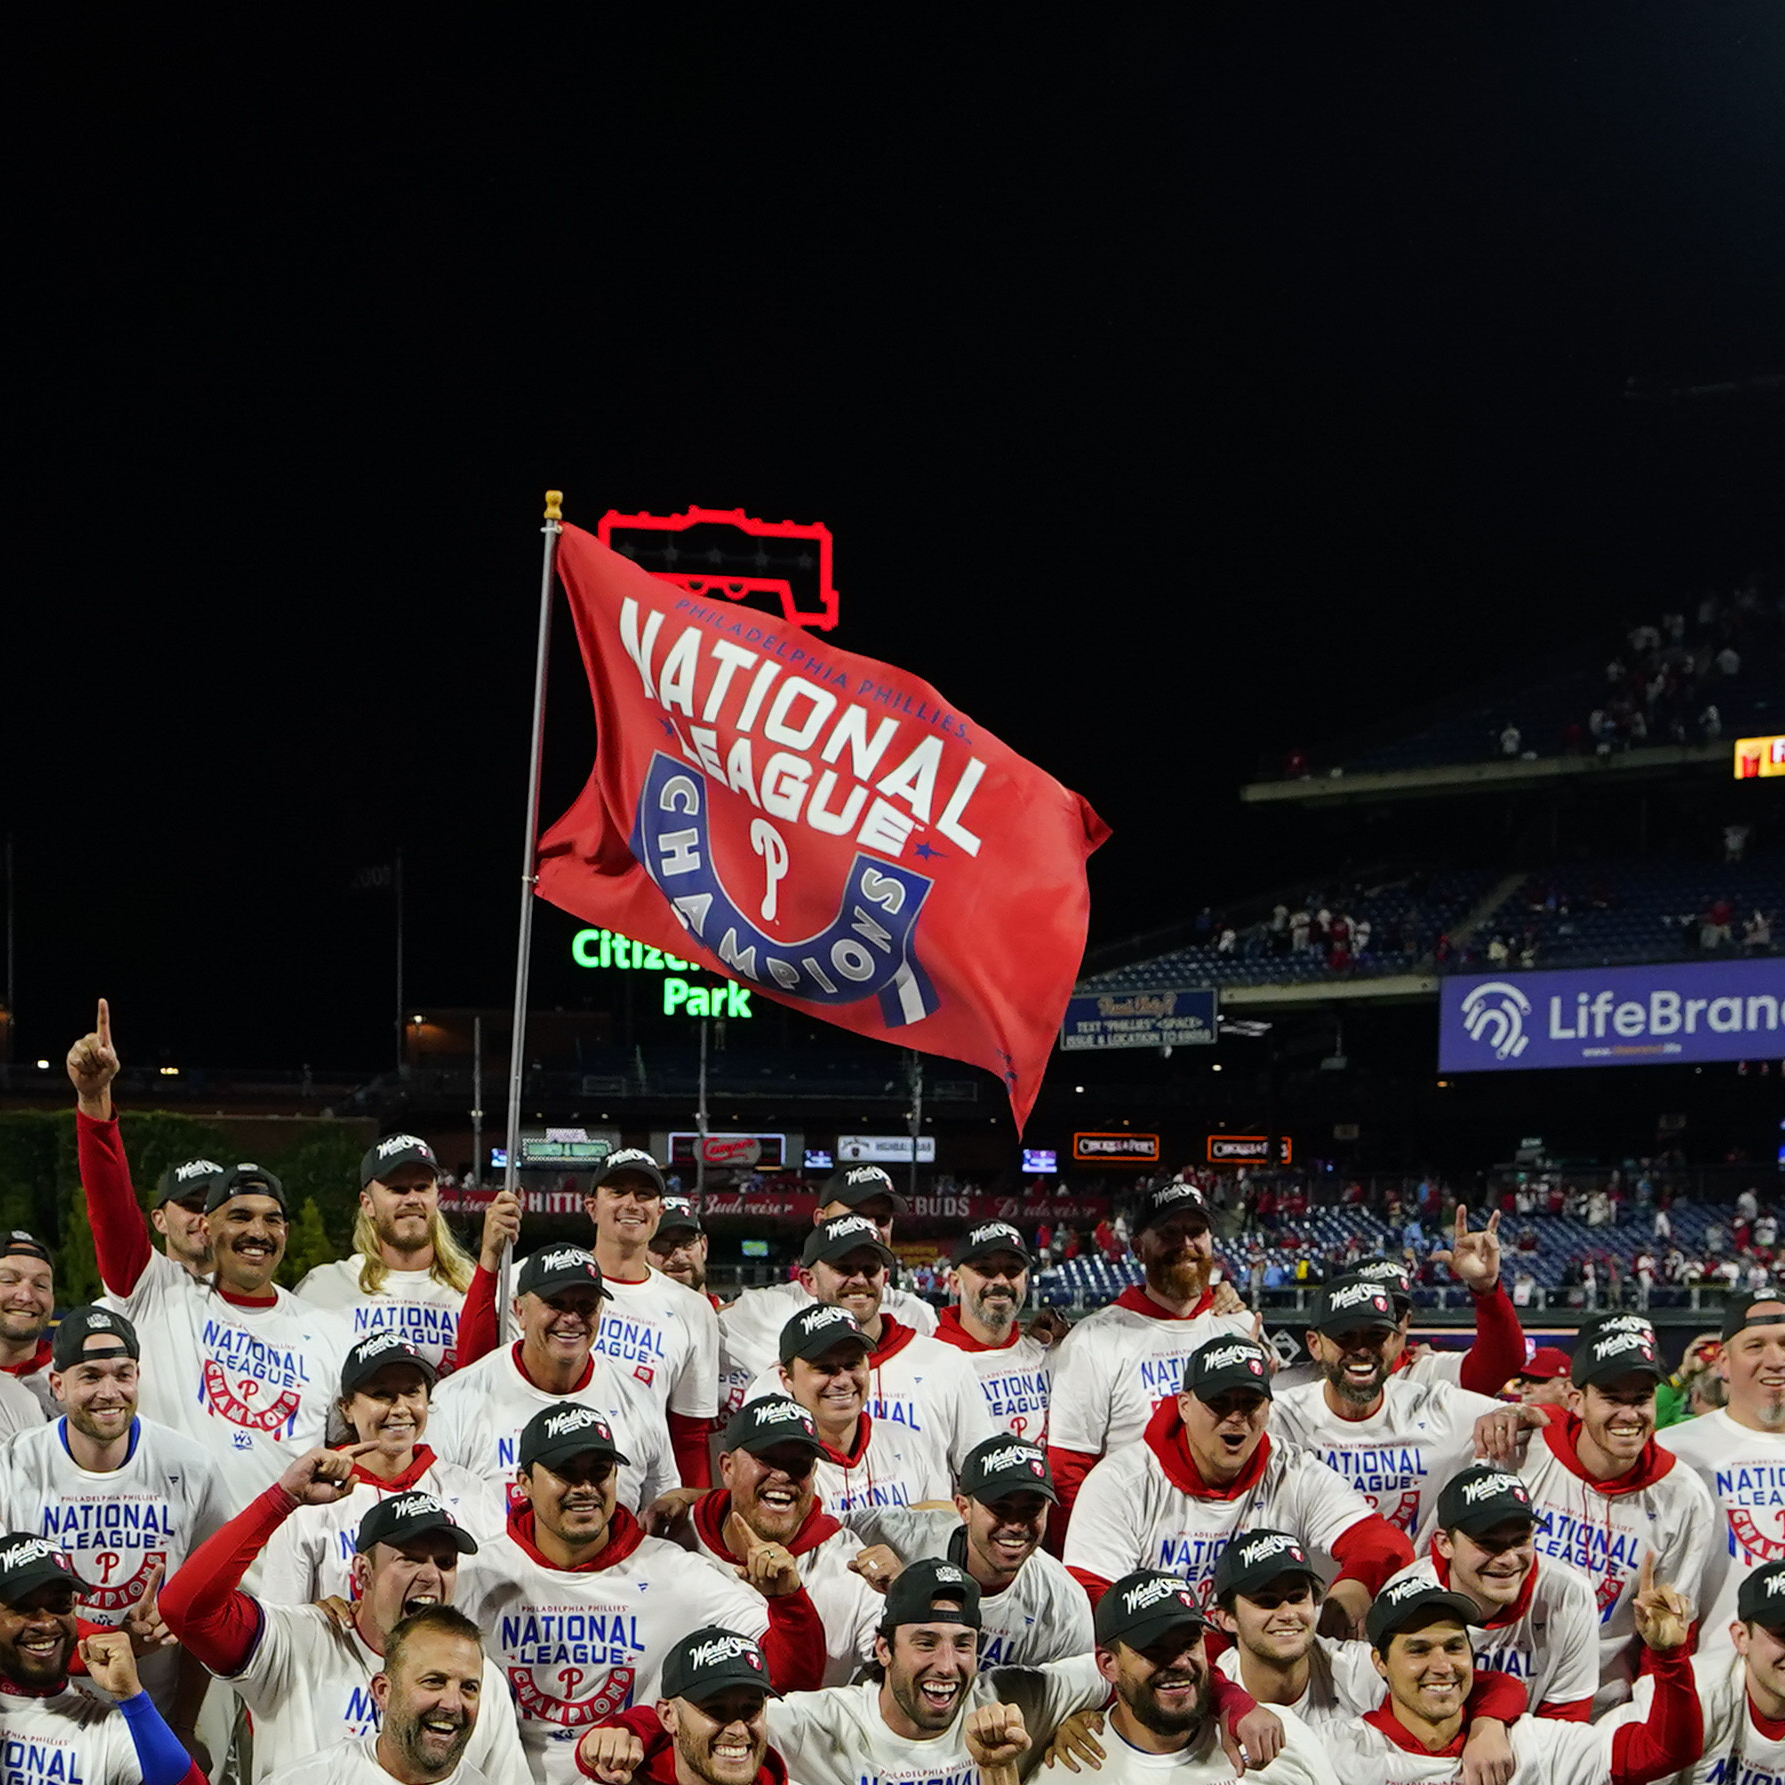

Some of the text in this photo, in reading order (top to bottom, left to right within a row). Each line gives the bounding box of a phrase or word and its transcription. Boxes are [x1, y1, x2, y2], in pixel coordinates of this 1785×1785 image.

[674, 597, 969, 742] PHILADELPHIA PHILLIES
[619, 597, 986, 857] NATIONAL
[680, 728, 912, 858] LEAGUE
[659, 773, 906, 995] CHAMPIONS
[663, 977, 753, 1018] Park
[204, 1320, 309, 1383] NATIONAL
[215, 1351, 295, 1388] LEAGUE
[43, 1504, 175, 1536] NATIONAL
[61, 1531, 158, 1549] LEAGUE
[502, 1614, 645, 1651] NATIONAL
[521, 1645, 628, 1664] LEAGUE
